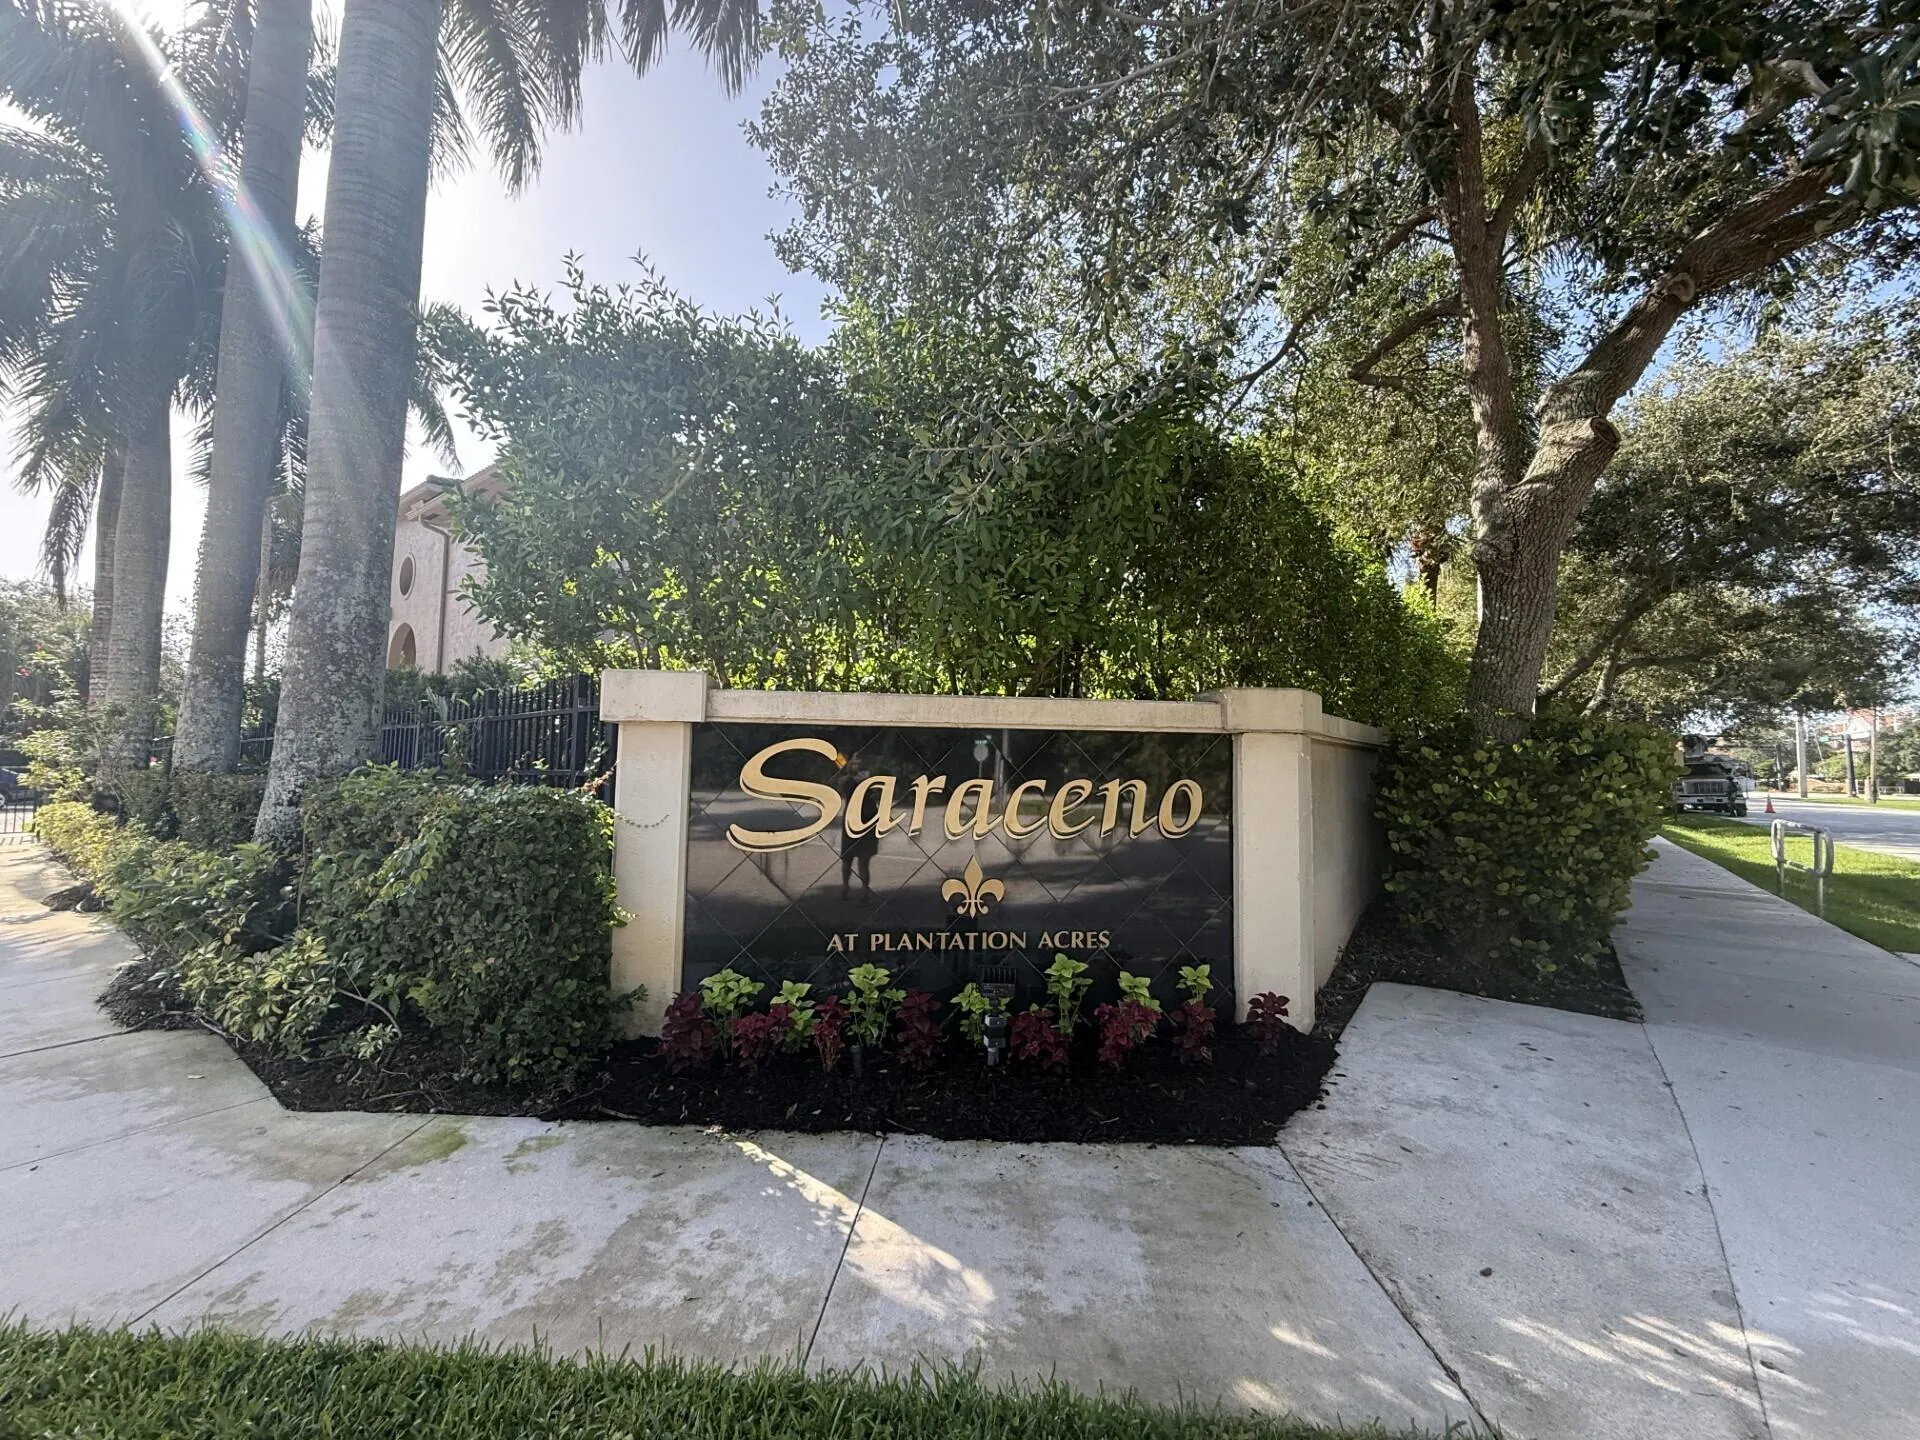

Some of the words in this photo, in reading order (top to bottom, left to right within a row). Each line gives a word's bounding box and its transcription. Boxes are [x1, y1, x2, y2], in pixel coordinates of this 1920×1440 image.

[726, 738, 1203, 852] Saraceno
[826, 933, 859, 952] AT
[870, 931, 1027, 951] PLANTATION
[1038, 930, 1111, 949] ACRES
